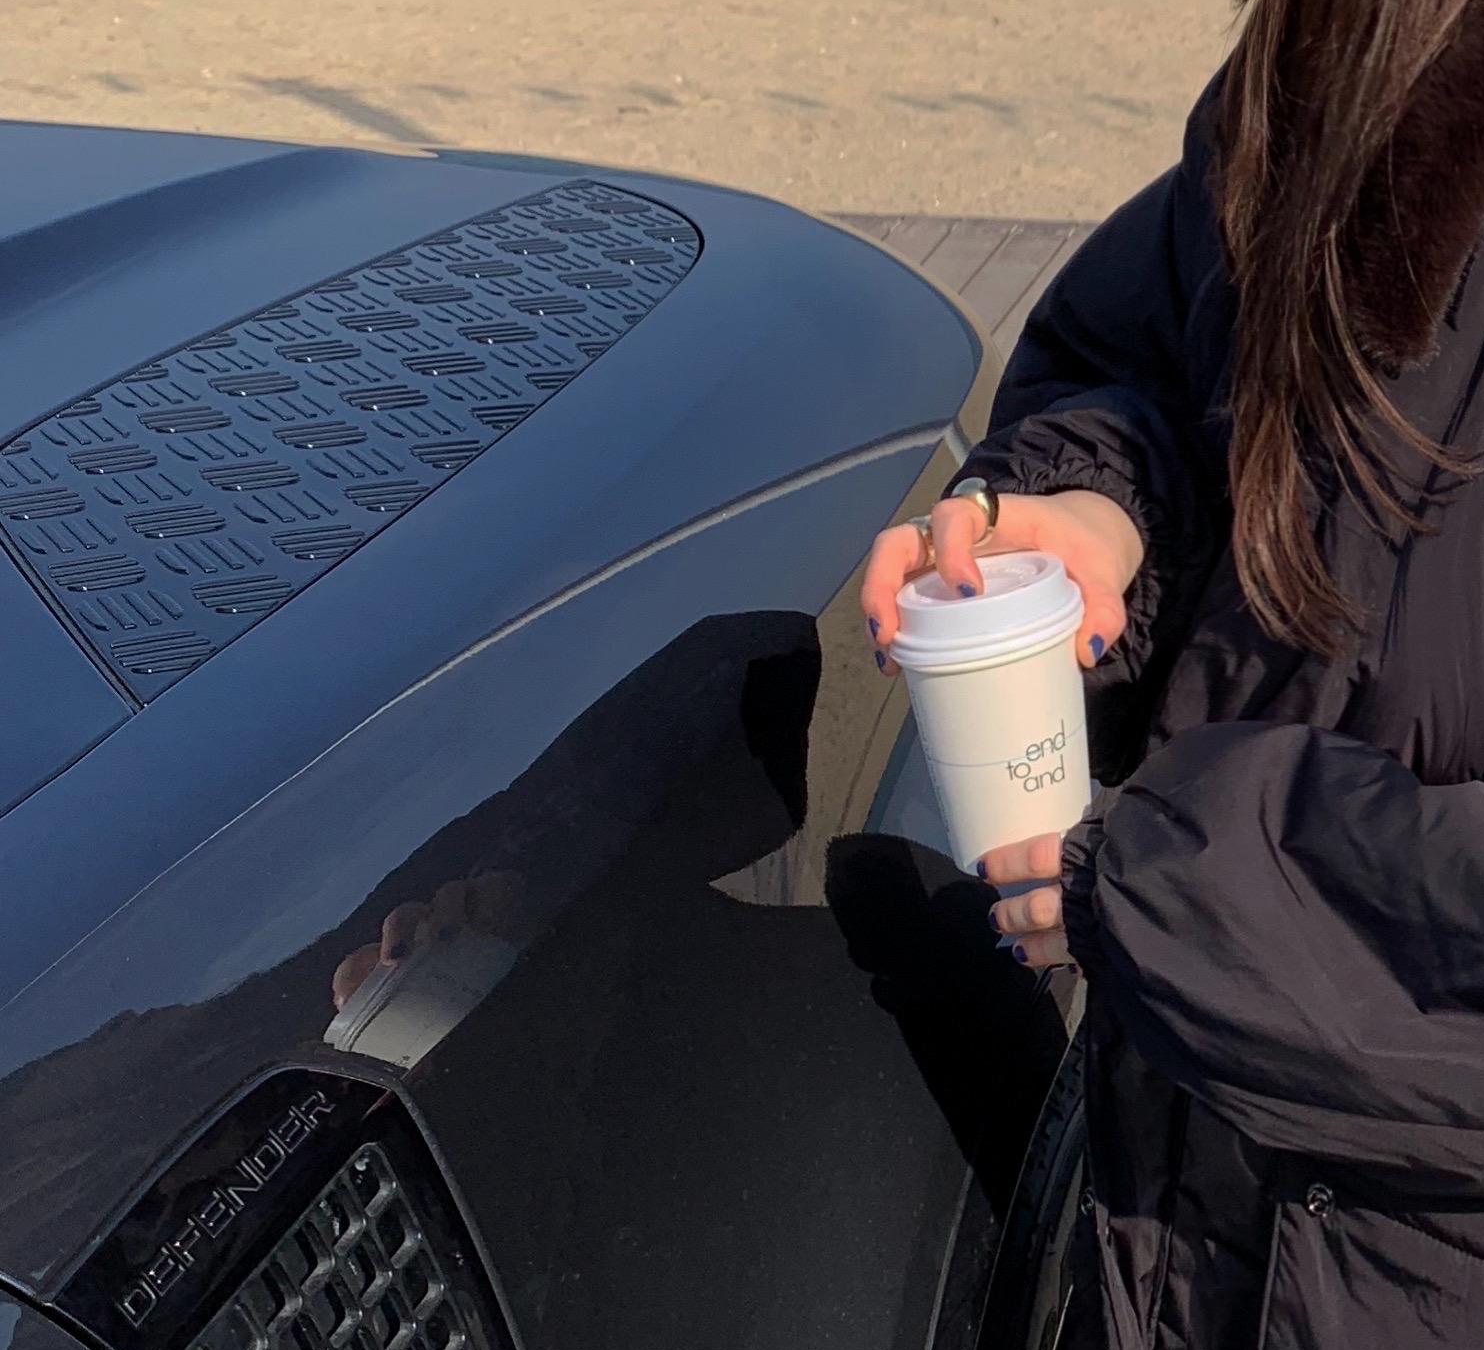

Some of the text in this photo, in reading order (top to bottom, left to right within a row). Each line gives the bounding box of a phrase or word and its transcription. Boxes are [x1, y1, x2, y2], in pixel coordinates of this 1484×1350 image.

[1025, 718, 1066, 762] end
[1005, 760, 1032, 781] to
[1022, 752, 1065, 793] and
[115, 1090, 336, 1329] DEFENDER
